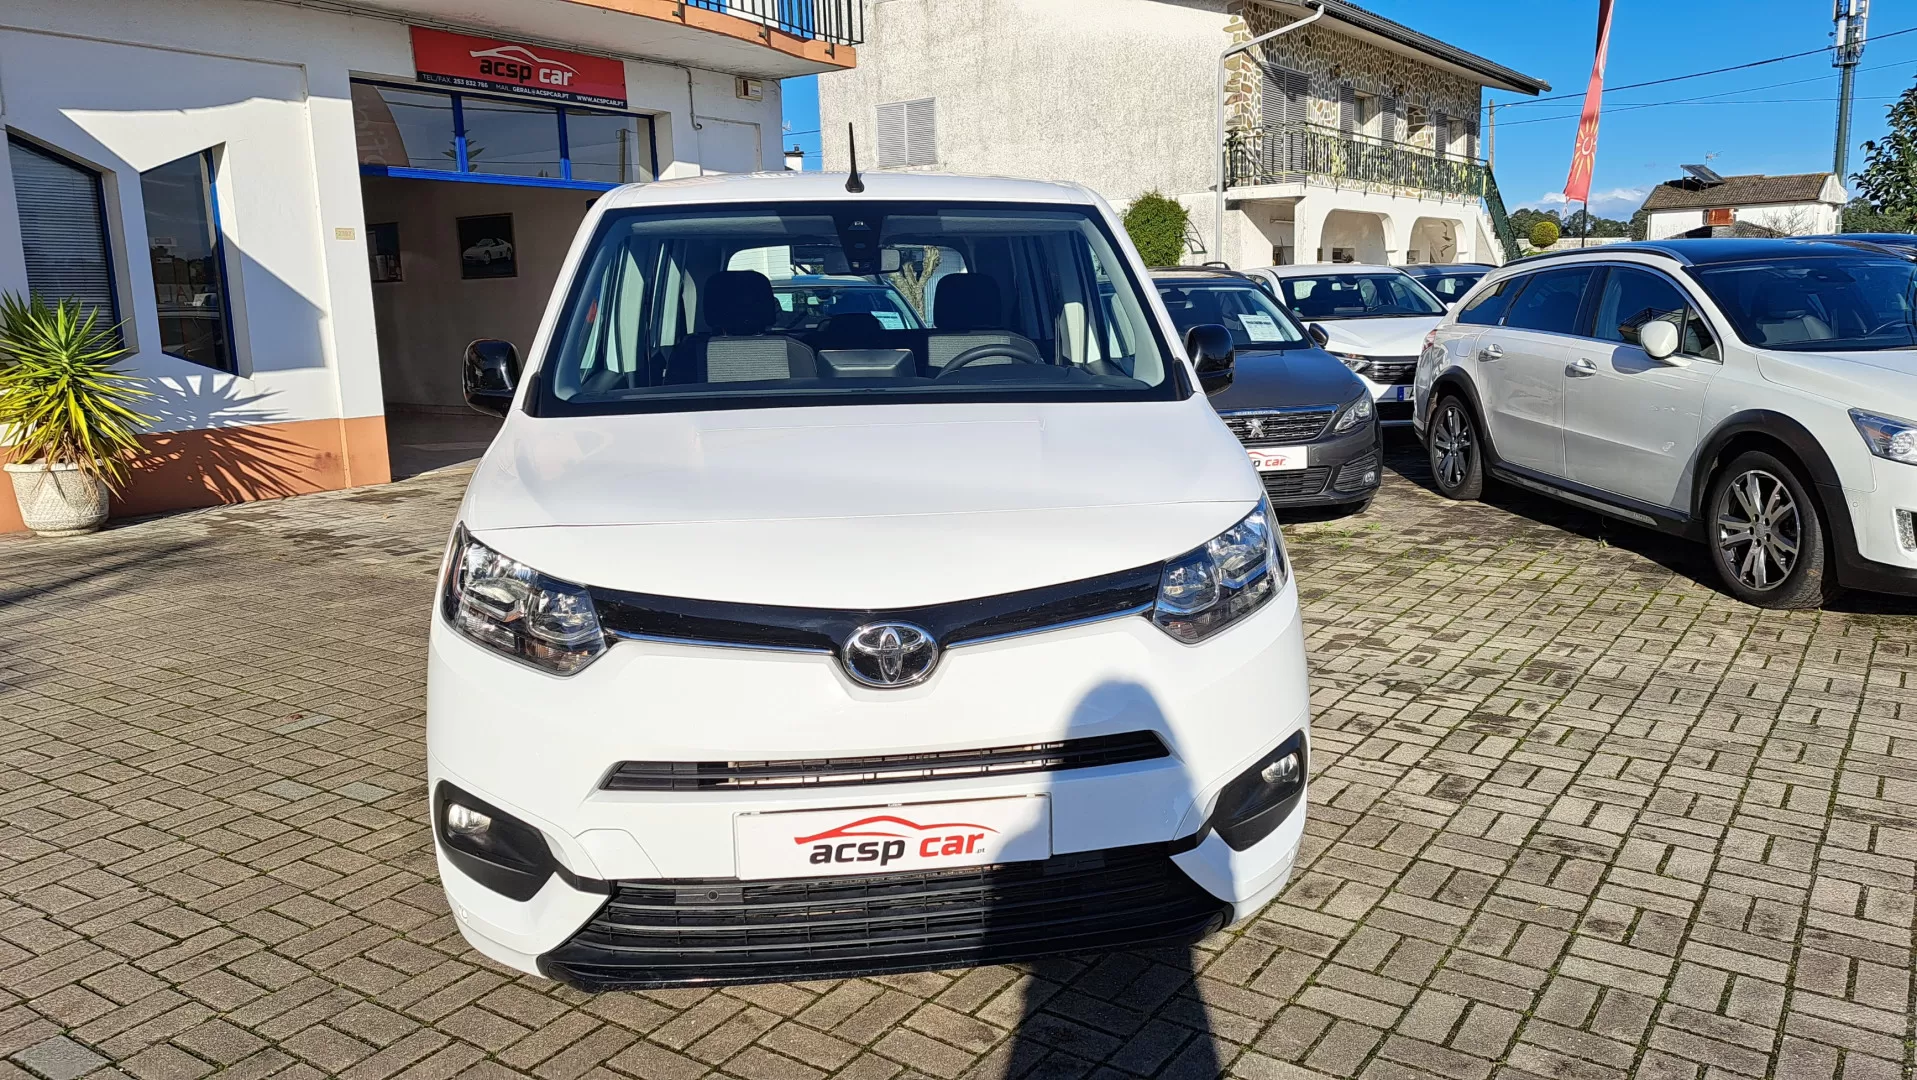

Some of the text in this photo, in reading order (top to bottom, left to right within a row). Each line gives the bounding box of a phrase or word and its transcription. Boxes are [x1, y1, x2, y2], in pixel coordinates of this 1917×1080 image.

[479, 59, 573, 86] acsp car
[453, 78, 465, 86] 253
[512, 86, 569, 99] GERAL@ACSPCAR.PT
[576, 95, 624, 107] WWW.ACSPCAR.PT
[1264, 458, 1286, 467] car
[809, 839, 905, 866] acsp
[919, 833, 984, 857] car
